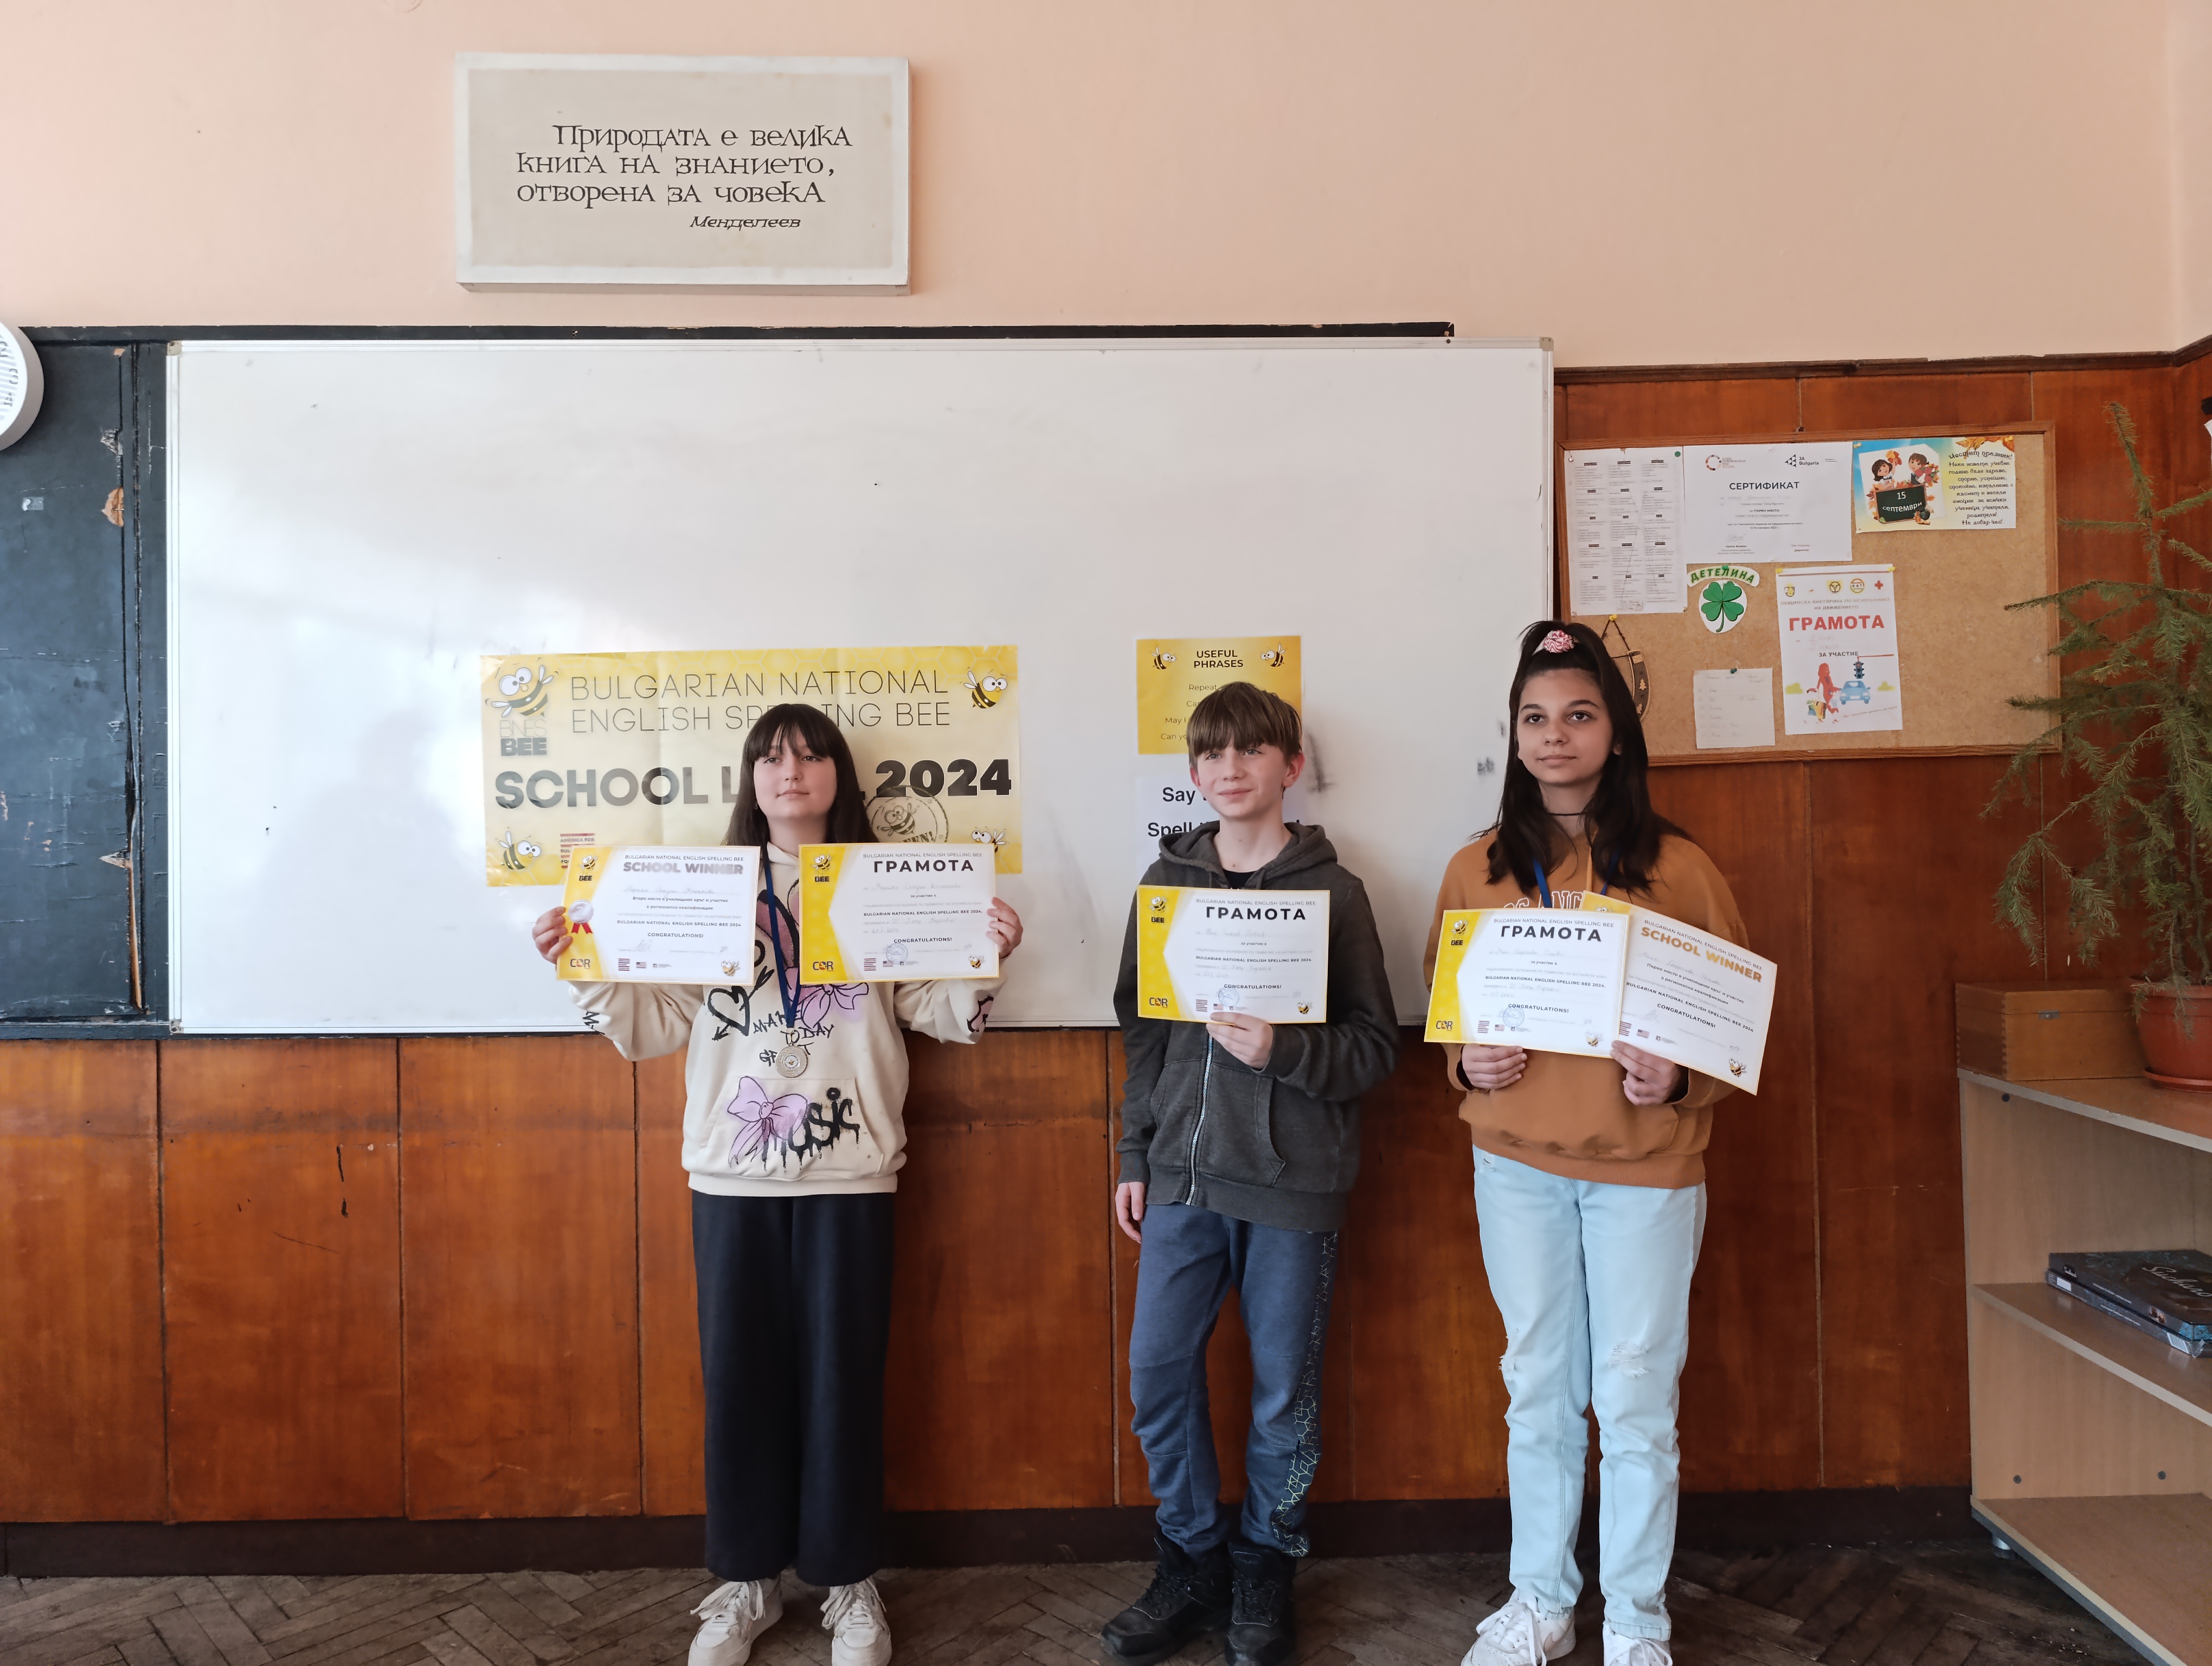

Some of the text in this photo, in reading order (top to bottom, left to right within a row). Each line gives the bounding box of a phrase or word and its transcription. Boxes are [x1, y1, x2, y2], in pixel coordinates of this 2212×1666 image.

[551, 125, 853, 152] Природата е велика
[516, 152, 834, 176] книга на знанието,
[517, 181, 825, 209] отворена за човека
[690, 216, 800, 231] Менделеев
[1729, 482, 1799, 490] СЕРТИФИКАТ
[1882, 502, 1922, 512] септември
[1690, 568, 1755, 584] ДЕТЕЛИНА
[1789, 614, 1885, 631] ГРАМОТА
[1197, 649, 1237, 658] USEFUL
[1194, 659, 1243, 668] PHRASES
[571, 669, 948, 700] BULGARIAN NATIONAL
[573, 702, 950, 733] ENGLISH SPING BEE
[500, 719, 547, 738] BNES
[500, 737, 547, 756] BEE
[495, 766, 708, 809] SCHOOL
[875, 758, 1013, 798] 2024
[1162, 787, 1195, 805] Say
[1148, 822, 1192, 837] Spell
[623, 862, 743, 874] SCHOOL WINNER
[874, 860, 973, 873] ГРАМОТА
[1206, 906, 1306, 920] ГРАМОТА
[1501, 925, 1601, 941] ГРАМОТА
[1644, 919, 1675, 933] BULGARIAN
[1677, 931, 1702, 944] NATIONAL
[1705, 942, 1726, 954] ENGLISH
[1727, 952, 1751, 965] SPELLING
[1641, 927, 1700, 956] SCHOOL
[1706, 950, 1761, 982] WINNER
[1508, 1003, 1568, 1013] CONGRATULATIONS!
[1626, 982, 1656, 993] BULGARIAN
[1658, 991, 1683, 1003] NATIONAL
[1685, 1001, 1706, 1011] ENGLISH
[1708, 1010, 1730, 1021] SPELLING
[1657, 1003, 1715, 1028] CONGRATULATIONS!
[781, 1022, 834, 1045] TODAY
